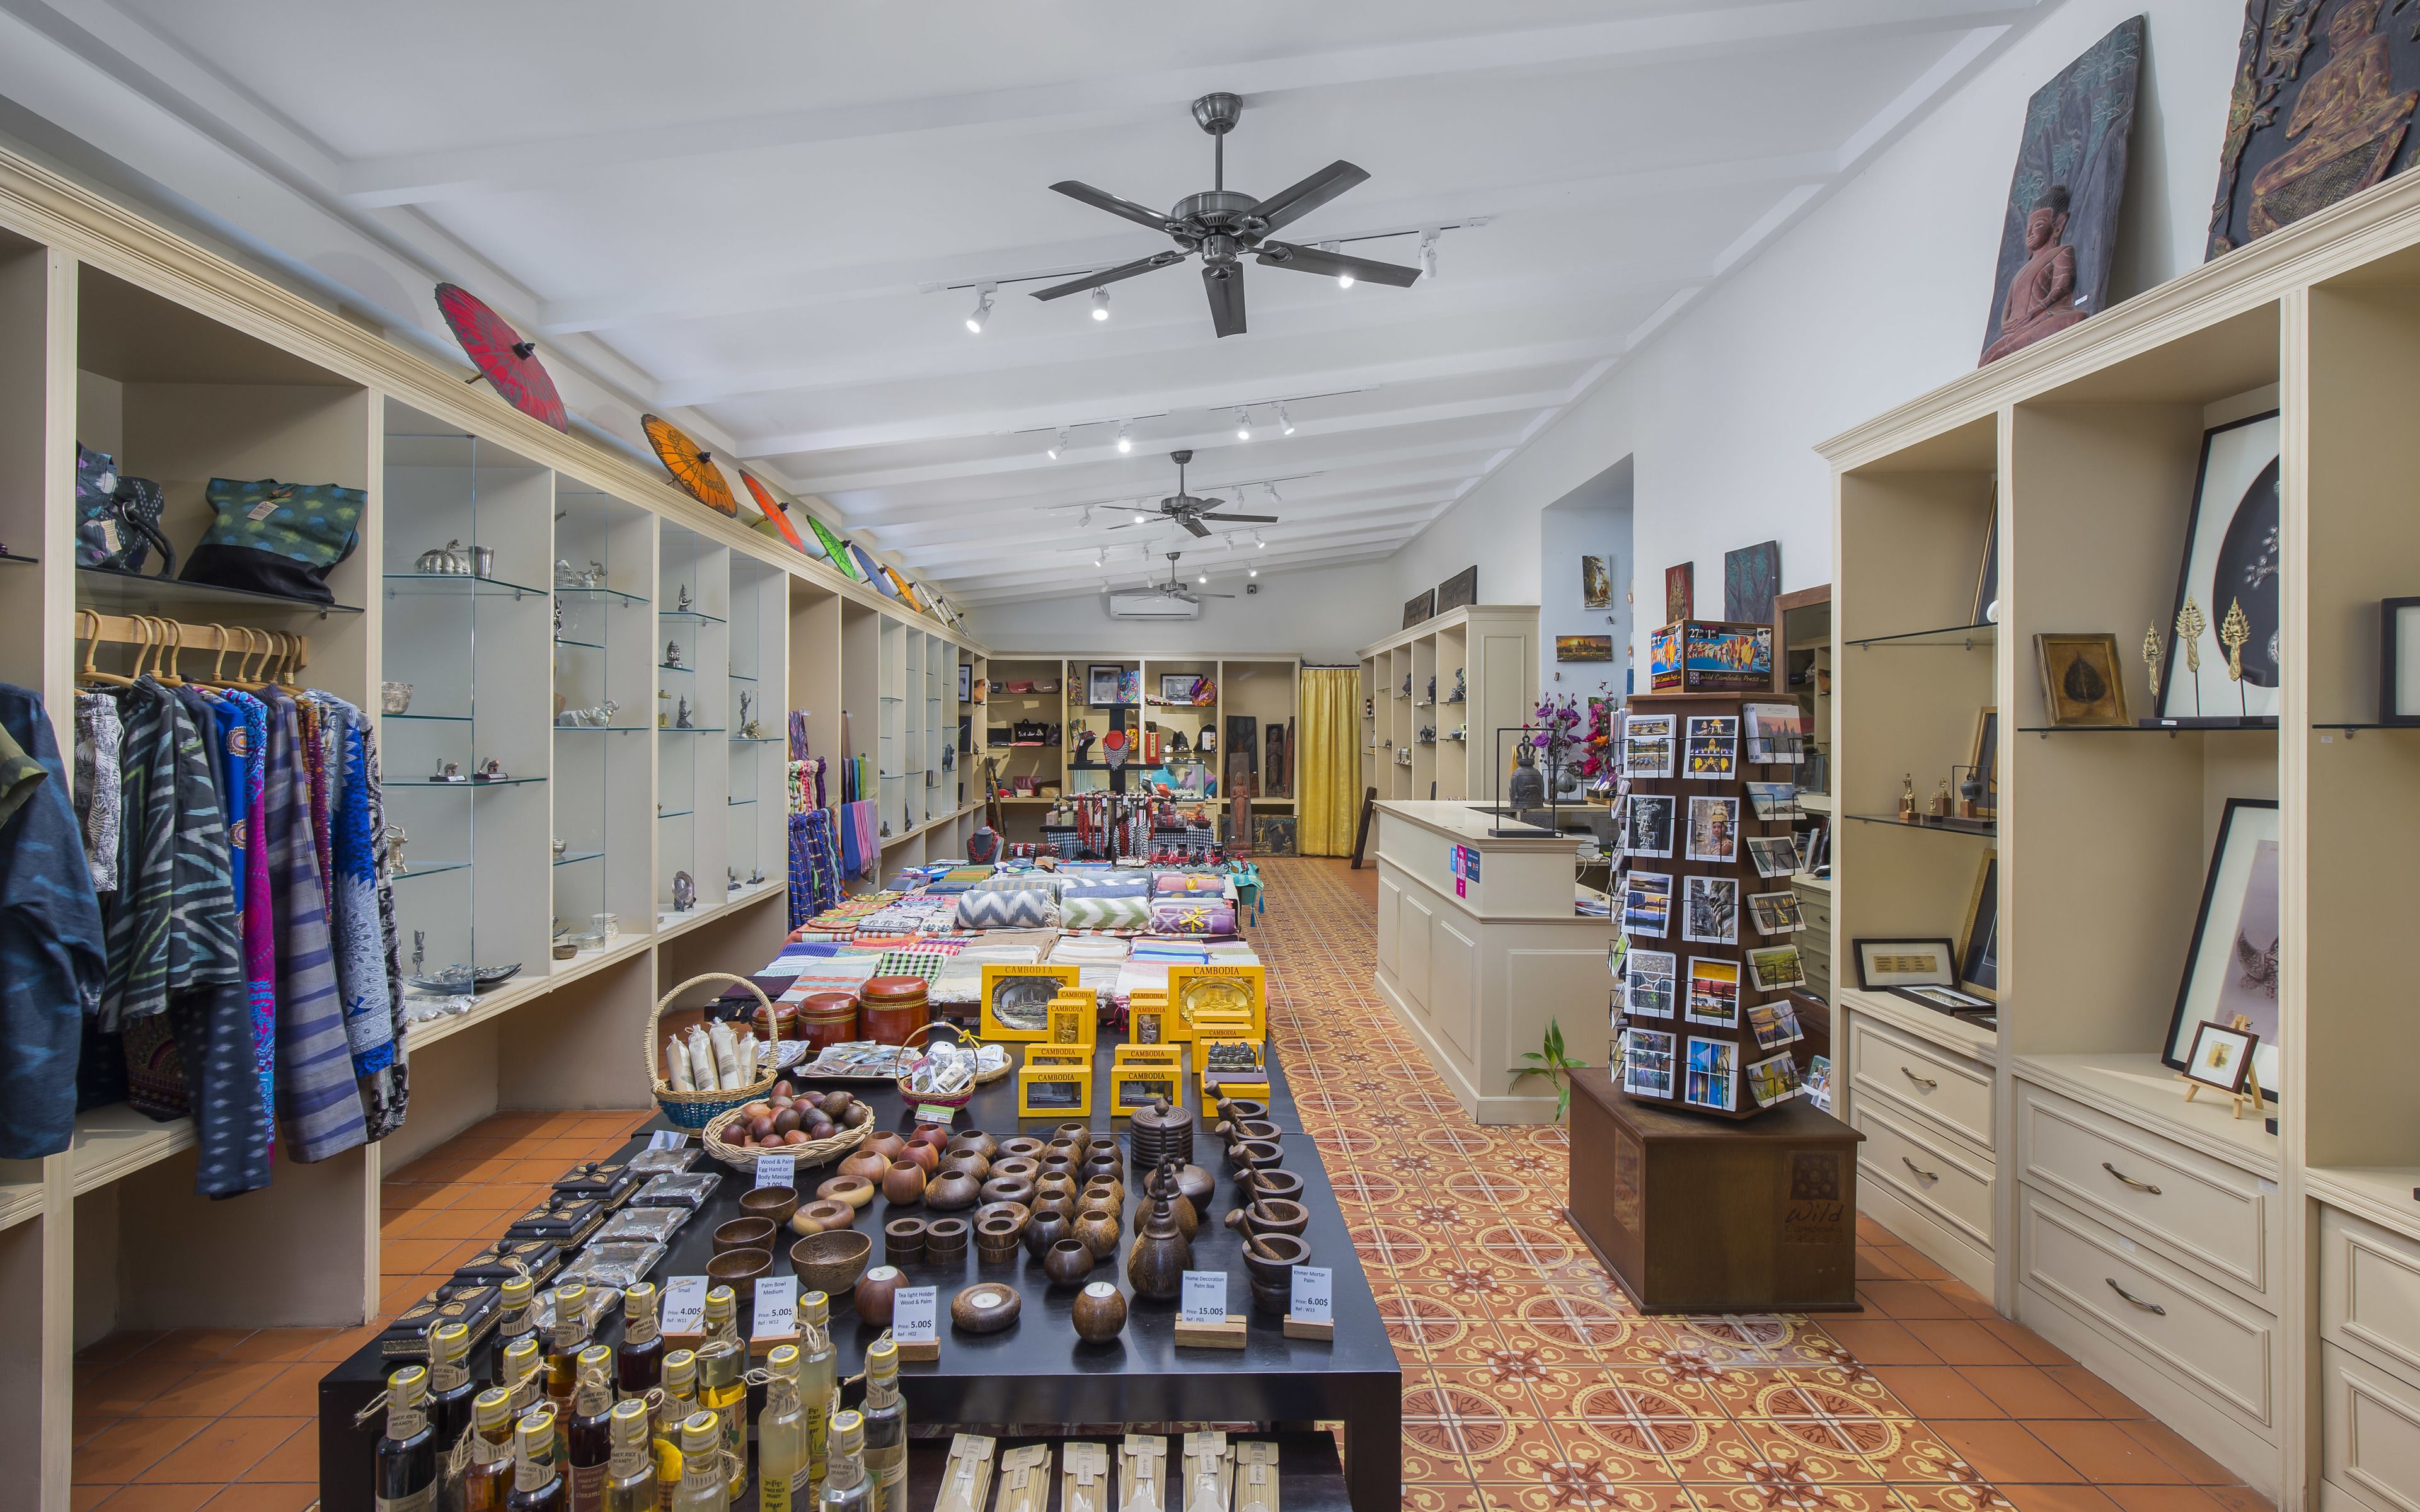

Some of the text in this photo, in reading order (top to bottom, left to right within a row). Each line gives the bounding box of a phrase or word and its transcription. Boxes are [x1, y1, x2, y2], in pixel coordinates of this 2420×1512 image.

[1005, 966, 1053, 974] CAMBODIA
[1194, 965, 1240, 975] CAMBODIA
[1040, 1048, 1076, 1056] CAMBODIA
[1130, 1050, 1165, 1058] CAMBODIA
[1038, 1074, 1075, 1082] CAMBODIA
[1128, 1072, 1165, 1080] CAMBODIA
[1785, 1201, 1845, 1223] Wild
[1308, 1297, 1328, 1307] 6.00$
[680, 1307, 701, 1315] 4.00$
[771, 1307, 792, 1317] 5.00$
[1199, 1307, 1224, 1316] 15.00$
[911, 1319, 932, 1329] 5.00$
[764, 1501, 783, 1510] ginger
